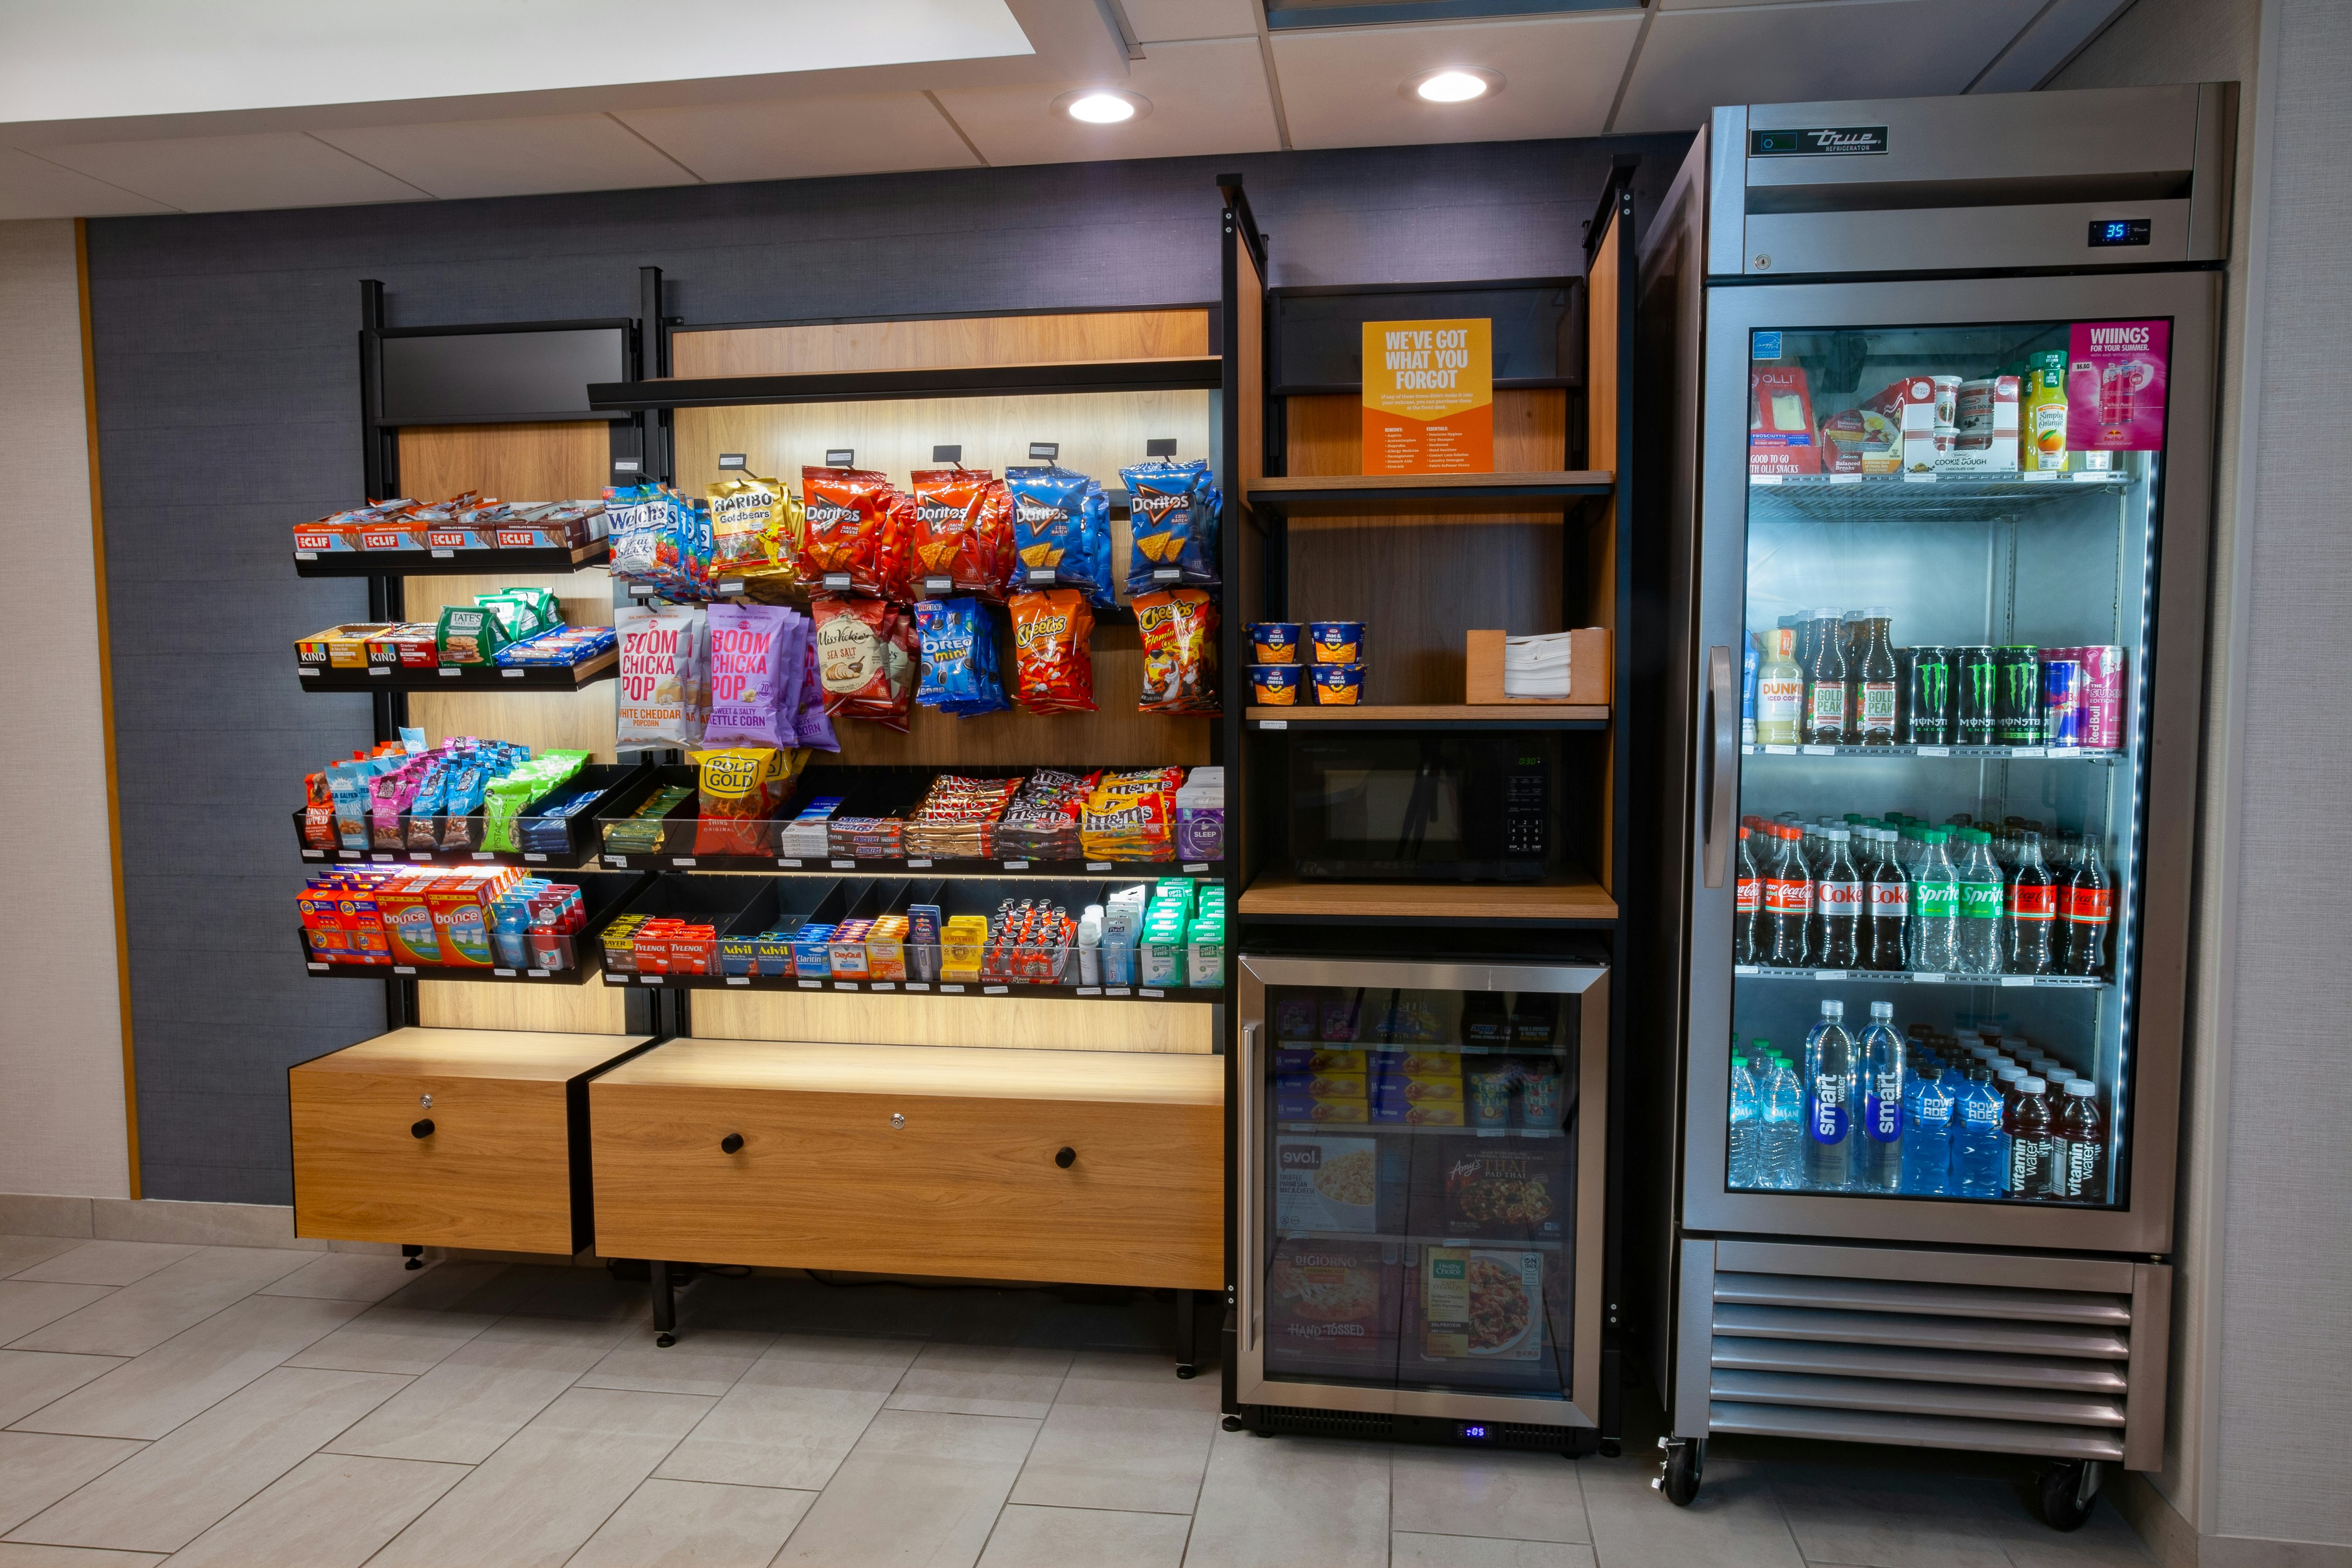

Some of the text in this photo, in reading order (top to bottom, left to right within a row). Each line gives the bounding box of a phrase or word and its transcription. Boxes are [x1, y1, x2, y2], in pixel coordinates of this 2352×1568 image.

[2107, 224, 2124, 237] 35
[1386, 330, 1468, 350] WE'VE GOT
[2091, 327, 2149, 344] WIIINGS
[1386, 350, 1468, 370] WHAT YOU
[1396, 370, 1458, 389] FORGOT
[1762, 375, 1793, 384] OLLI
[2039, 410, 2063, 420] Simply
[2038, 420, 2063, 428] Orange
[1750, 455, 1789, 463] GOOD TO GO
[1761, 465, 1774, 474] OLLI
[1776, 465, 1798, 474] SNACKS
[714, 493, 773, 512] HARIBO
[1132, 495, 1190, 512] Doritos
[607, 505, 665, 529] Welch's
[720, 511, 770, 523] Goldbears
[806, 506, 860, 522] Doritos
[917, 505, 968, 522] Doritos
[304, 537, 328, 547] CLIF
[437, 535, 462, 544] CLIF
[453, 614, 482, 622] TATE'S
[1139, 600, 1195, 630] Cheetos
[817, 631, 837, 646] Miss
[1017, 617, 1066, 647] Cheetos
[624, 630, 676, 654] BOOM
[712, 630, 771, 655] BOOM
[923, 640, 973, 654] OREO
[301, 653, 326, 661] KIND
[827, 647, 856, 660] SEA SALT
[935, 648, 966, 662] mini
[622, 655, 675, 675] CHICKA
[712, 655, 767, 675] CHICKA
[622, 676, 655, 701] POP
[1817, 690, 1842, 702] GOLD
[1869, 691, 1893, 703] GOLD
[1817, 701, 1842, 712] PEAK
[1869, 702, 1893, 713] PEAK
[640, 710, 681, 720] CHEDDAR
[741, 716, 766, 727] CORN
[712, 760, 755, 773] ROLD
[710, 774, 753, 788] GOLD
[1778, 884, 1814, 898] Coca-Cola
[1819, 884, 1863, 903] Coke
[1917, 884, 1959, 903] Sprite
[384, 912, 426, 925] bounce
[634, 943, 666, 952] TYLENOL
[723, 944, 752, 954] Advil
[796, 954, 821, 963] Claritin
[1838, 1075, 1846, 1102] water
[1819, 1074, 1837, 1136] smart
[1968, 1110, 1992, 1120] ADE
[1484, 1159, 1527, 1171] THAI
[2013, 1139, 2027, 1191] vitamin
[2026, 1140, 2037, 1176] water
[1450, 1159, 1481, 1180] Amy's
[2070, 1143, 2083, 1196] vitamin
[1439, 1262, 1461, 1271] Healthy
